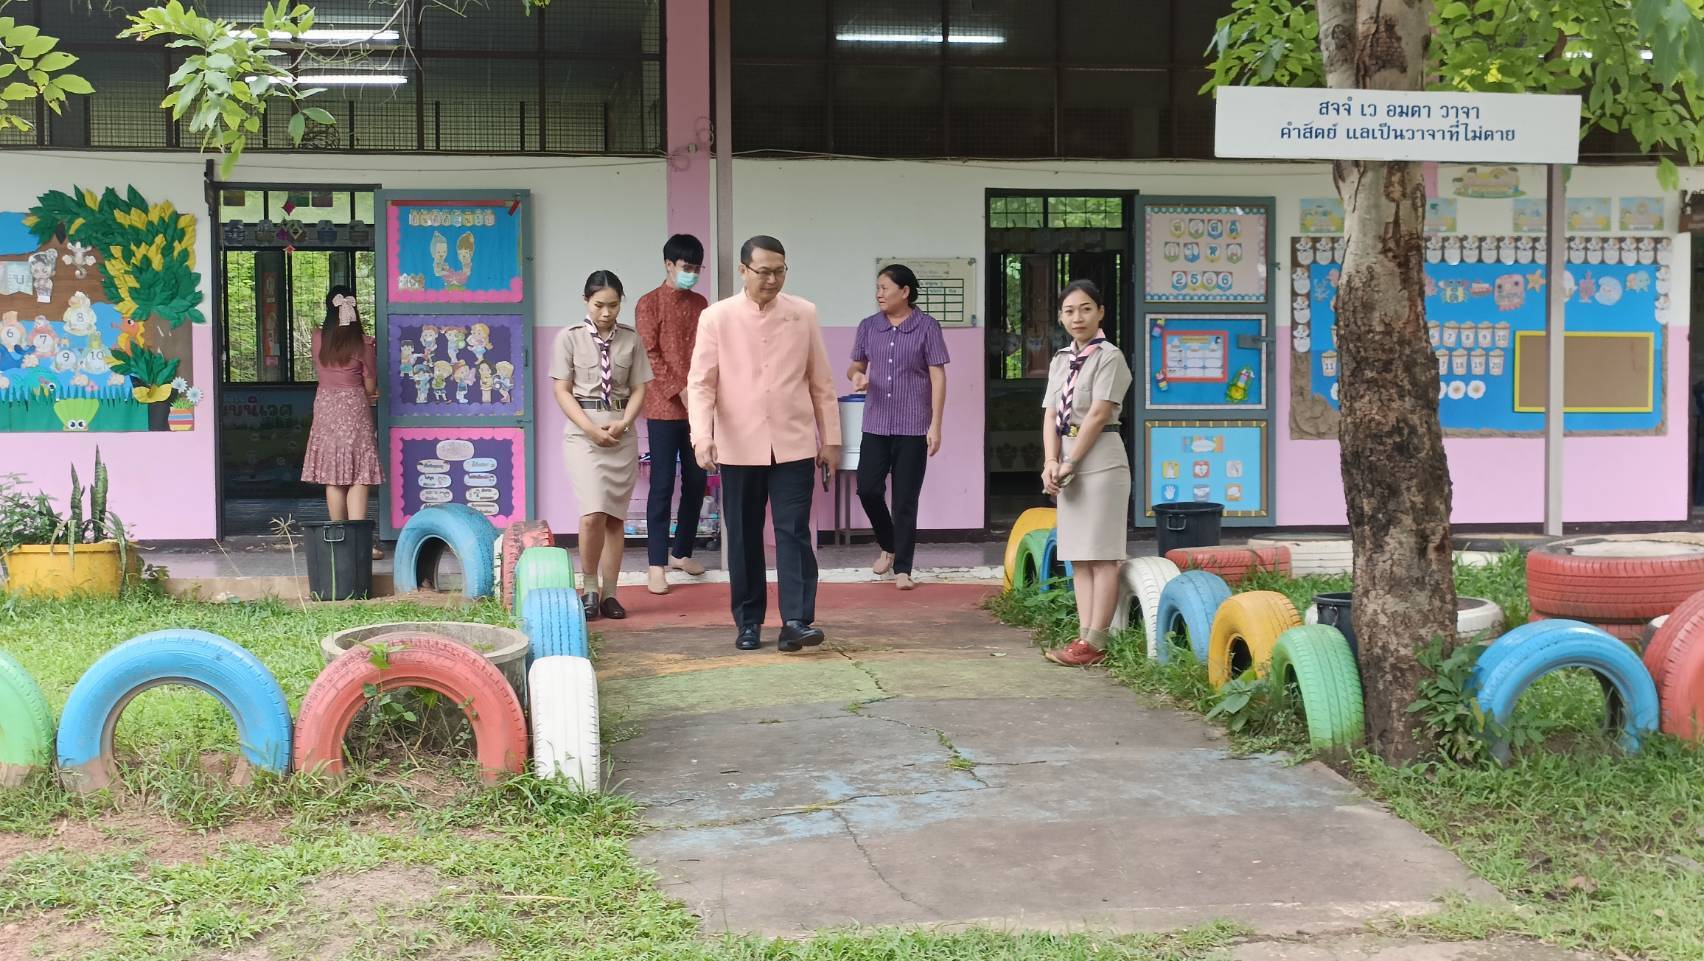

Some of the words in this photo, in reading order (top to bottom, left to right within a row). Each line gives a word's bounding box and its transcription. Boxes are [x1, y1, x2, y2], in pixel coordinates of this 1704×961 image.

[1361, 103, 1376, 117] เว
[1439, 104, 1480, 119] วาจา
[6, 329, 14, 338] 6
[40, 335, 47, 345] 7
[62, 352, 70, 362] 9
[90, 351, 104, 361] 10
